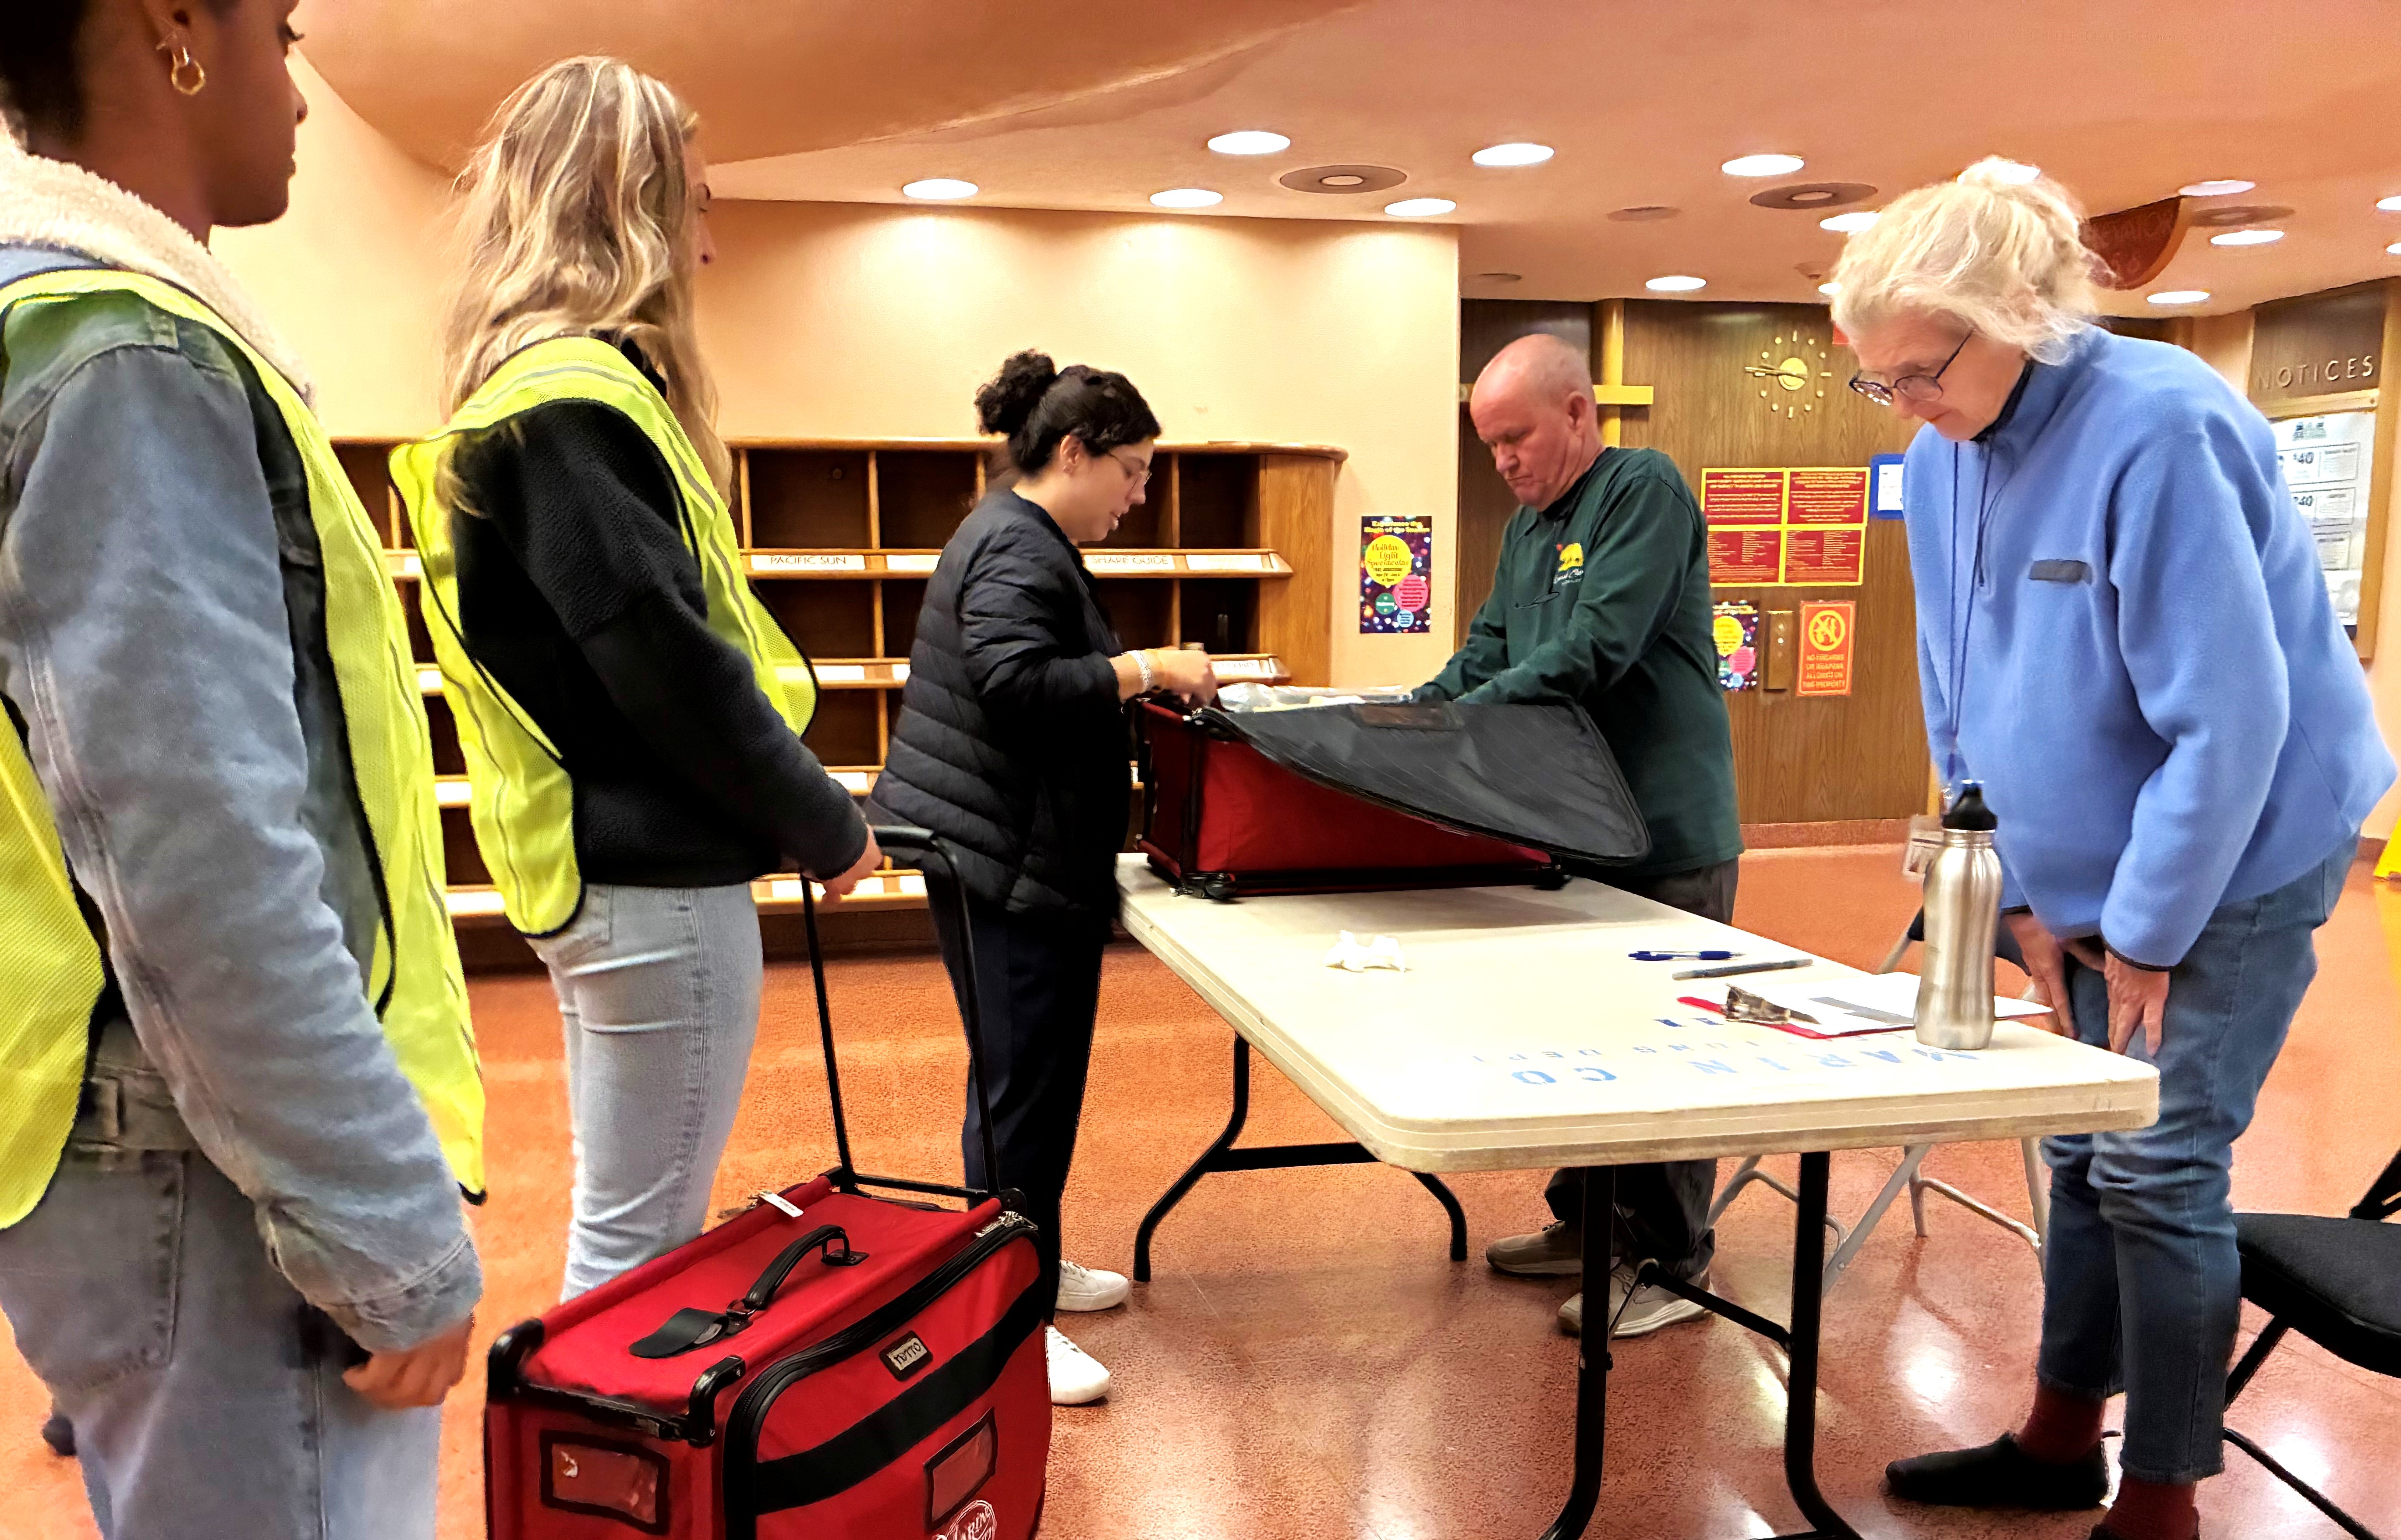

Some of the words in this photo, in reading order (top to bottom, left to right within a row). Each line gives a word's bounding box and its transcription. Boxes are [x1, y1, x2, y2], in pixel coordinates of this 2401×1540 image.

[2258, 355, 2374, 390] NOTICES
[771, 556, 816, 565] PACIFIC
[820, 556, 846, 565] SUN
[1132, 555, 1169, 565] GUIDE
[1379, 552, 1399, 561] Light
[1367, 559, 1409, 568] Spectacular
[1687, 1048, 1980, 1074] MARIN
[1510, 1067, 1617, 1085] CO
